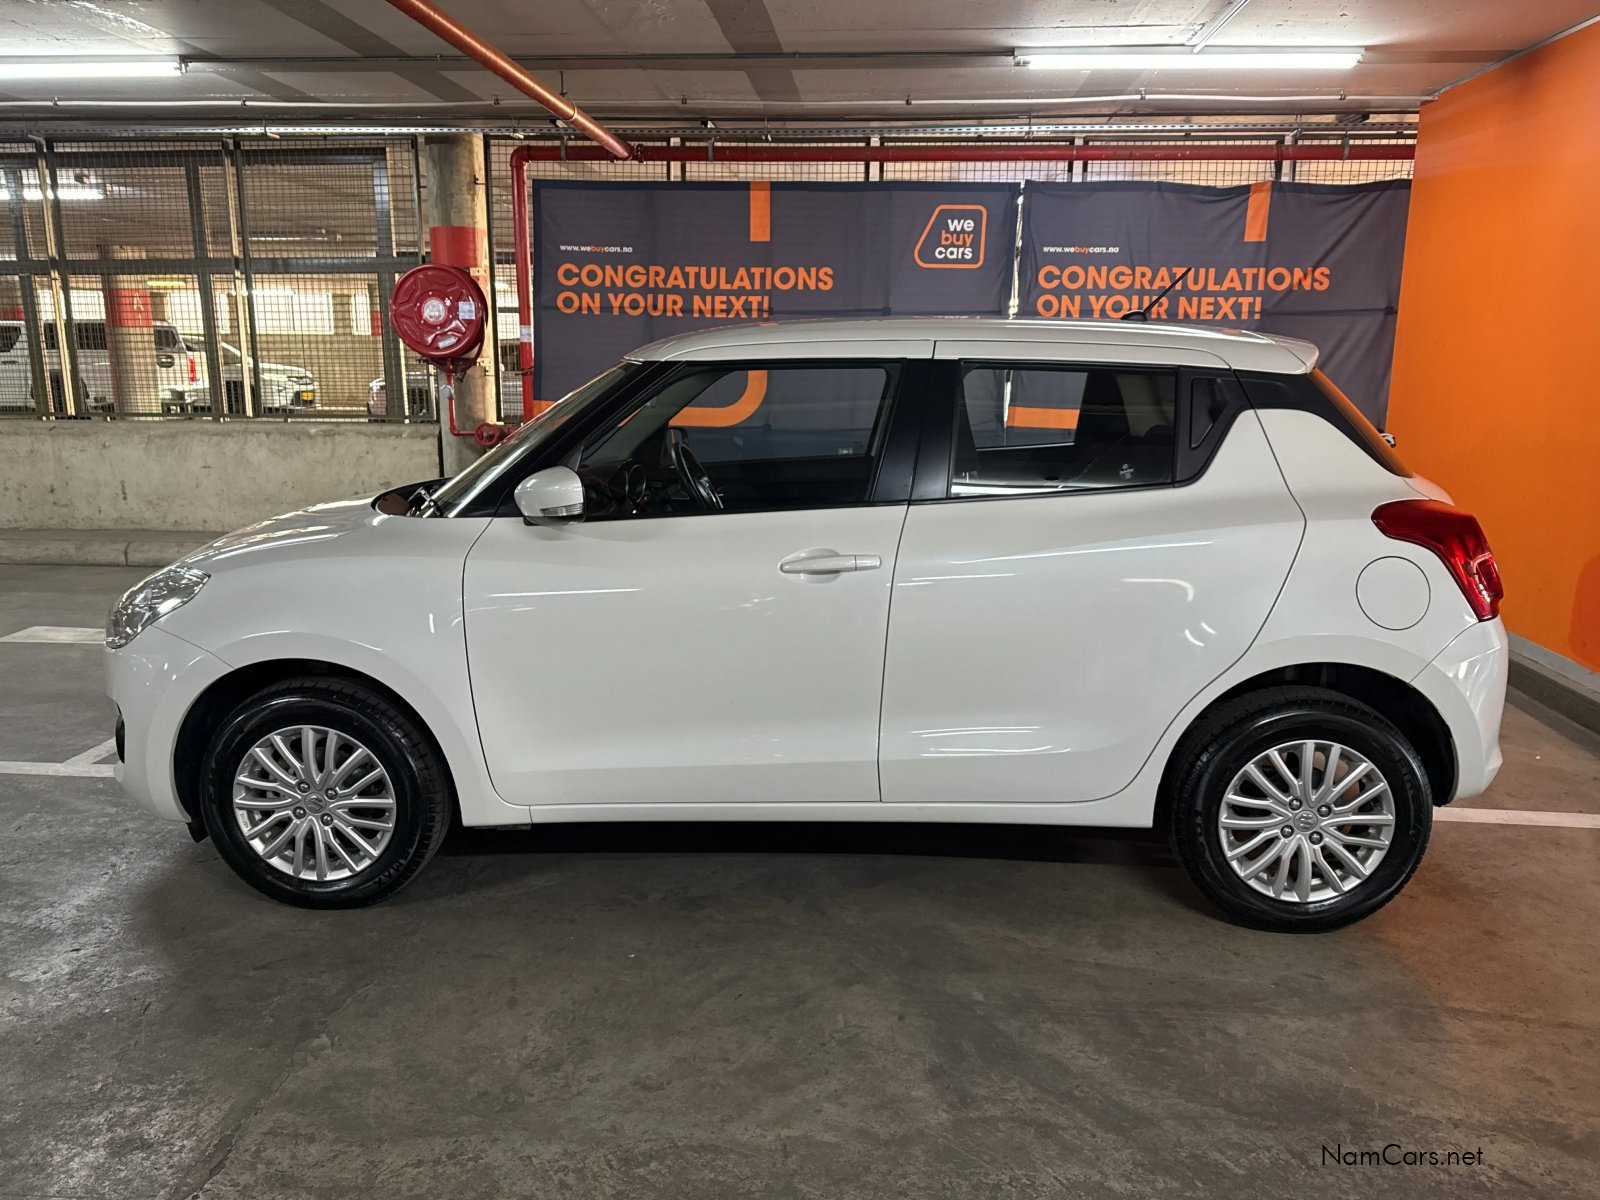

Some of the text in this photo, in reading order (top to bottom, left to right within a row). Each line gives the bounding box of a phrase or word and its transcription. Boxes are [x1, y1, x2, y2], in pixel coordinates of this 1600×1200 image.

[947, 219, 975, 232] we
[941, 230, 974, 248] buy
[1042, 245, 1120, 255] www.webuycars.na
[934, 246, 973, 259] cars
[556, 263, 834, 291] CONGRATULATIONS
[1037, 264, 1331, 292] CONGRATULATIONS
[556, 290, 769, 319] ON YOUR NEXT!
[1036, 293, 1262, 320] ON YOUR NEXT!
